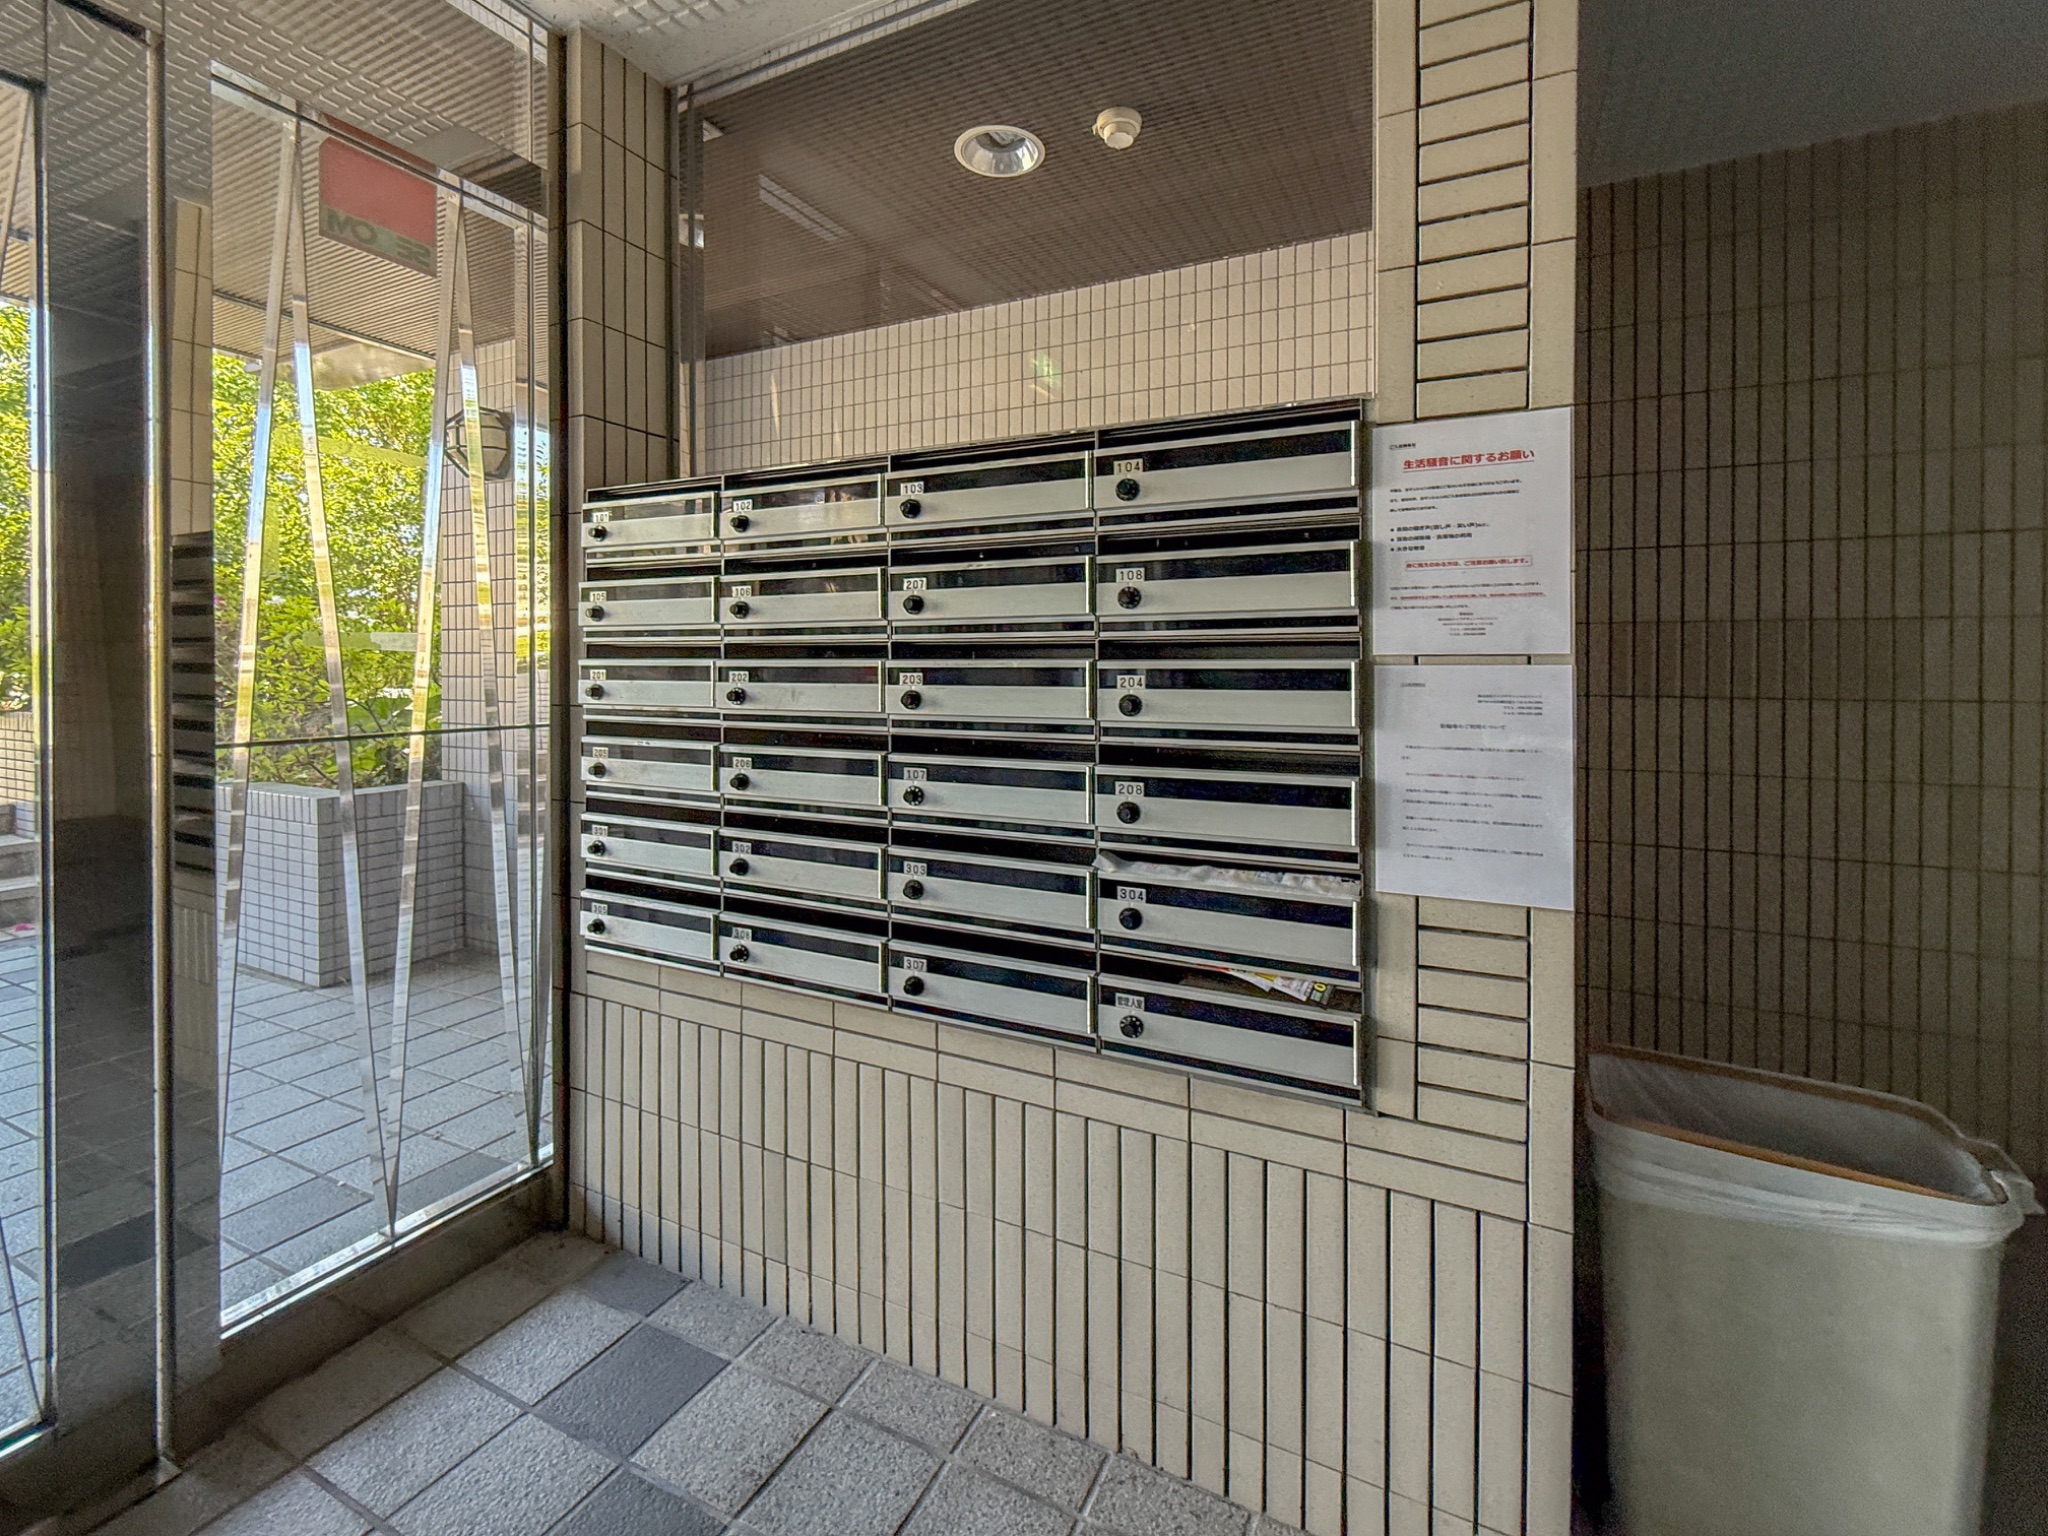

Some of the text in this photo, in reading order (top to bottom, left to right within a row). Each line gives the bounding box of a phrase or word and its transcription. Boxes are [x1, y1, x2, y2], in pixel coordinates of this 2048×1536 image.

[1402, 449, 1535, 470] 生活騒音に関するお願い
[1117, 462, 1141, 472] 104
[904, 484, 923, 494] 103
[735, 502, 751, 511] 102
[595, 513, 609, 522] 101
[1119, 570, 1143, 581] 108
[906, 580, 925, 590] 207
[592, 593, 606, 601] 105
[735, 588, 751, 597] 106
[592, 671, 606, 680] 201
[731, 673, 748, 682] 202
[902, 675, 922, 685] 203
[1119, 677, 1143, 688] 204
[906, 770, 926, 780] 107
[1118, 784, 1143, 795] 208
[735, 844, 751, 854] 302
[906, 864, 926, 875] 303
[1119, 889, 1144, 900] 304
[906, 959, 925, 970] 307
